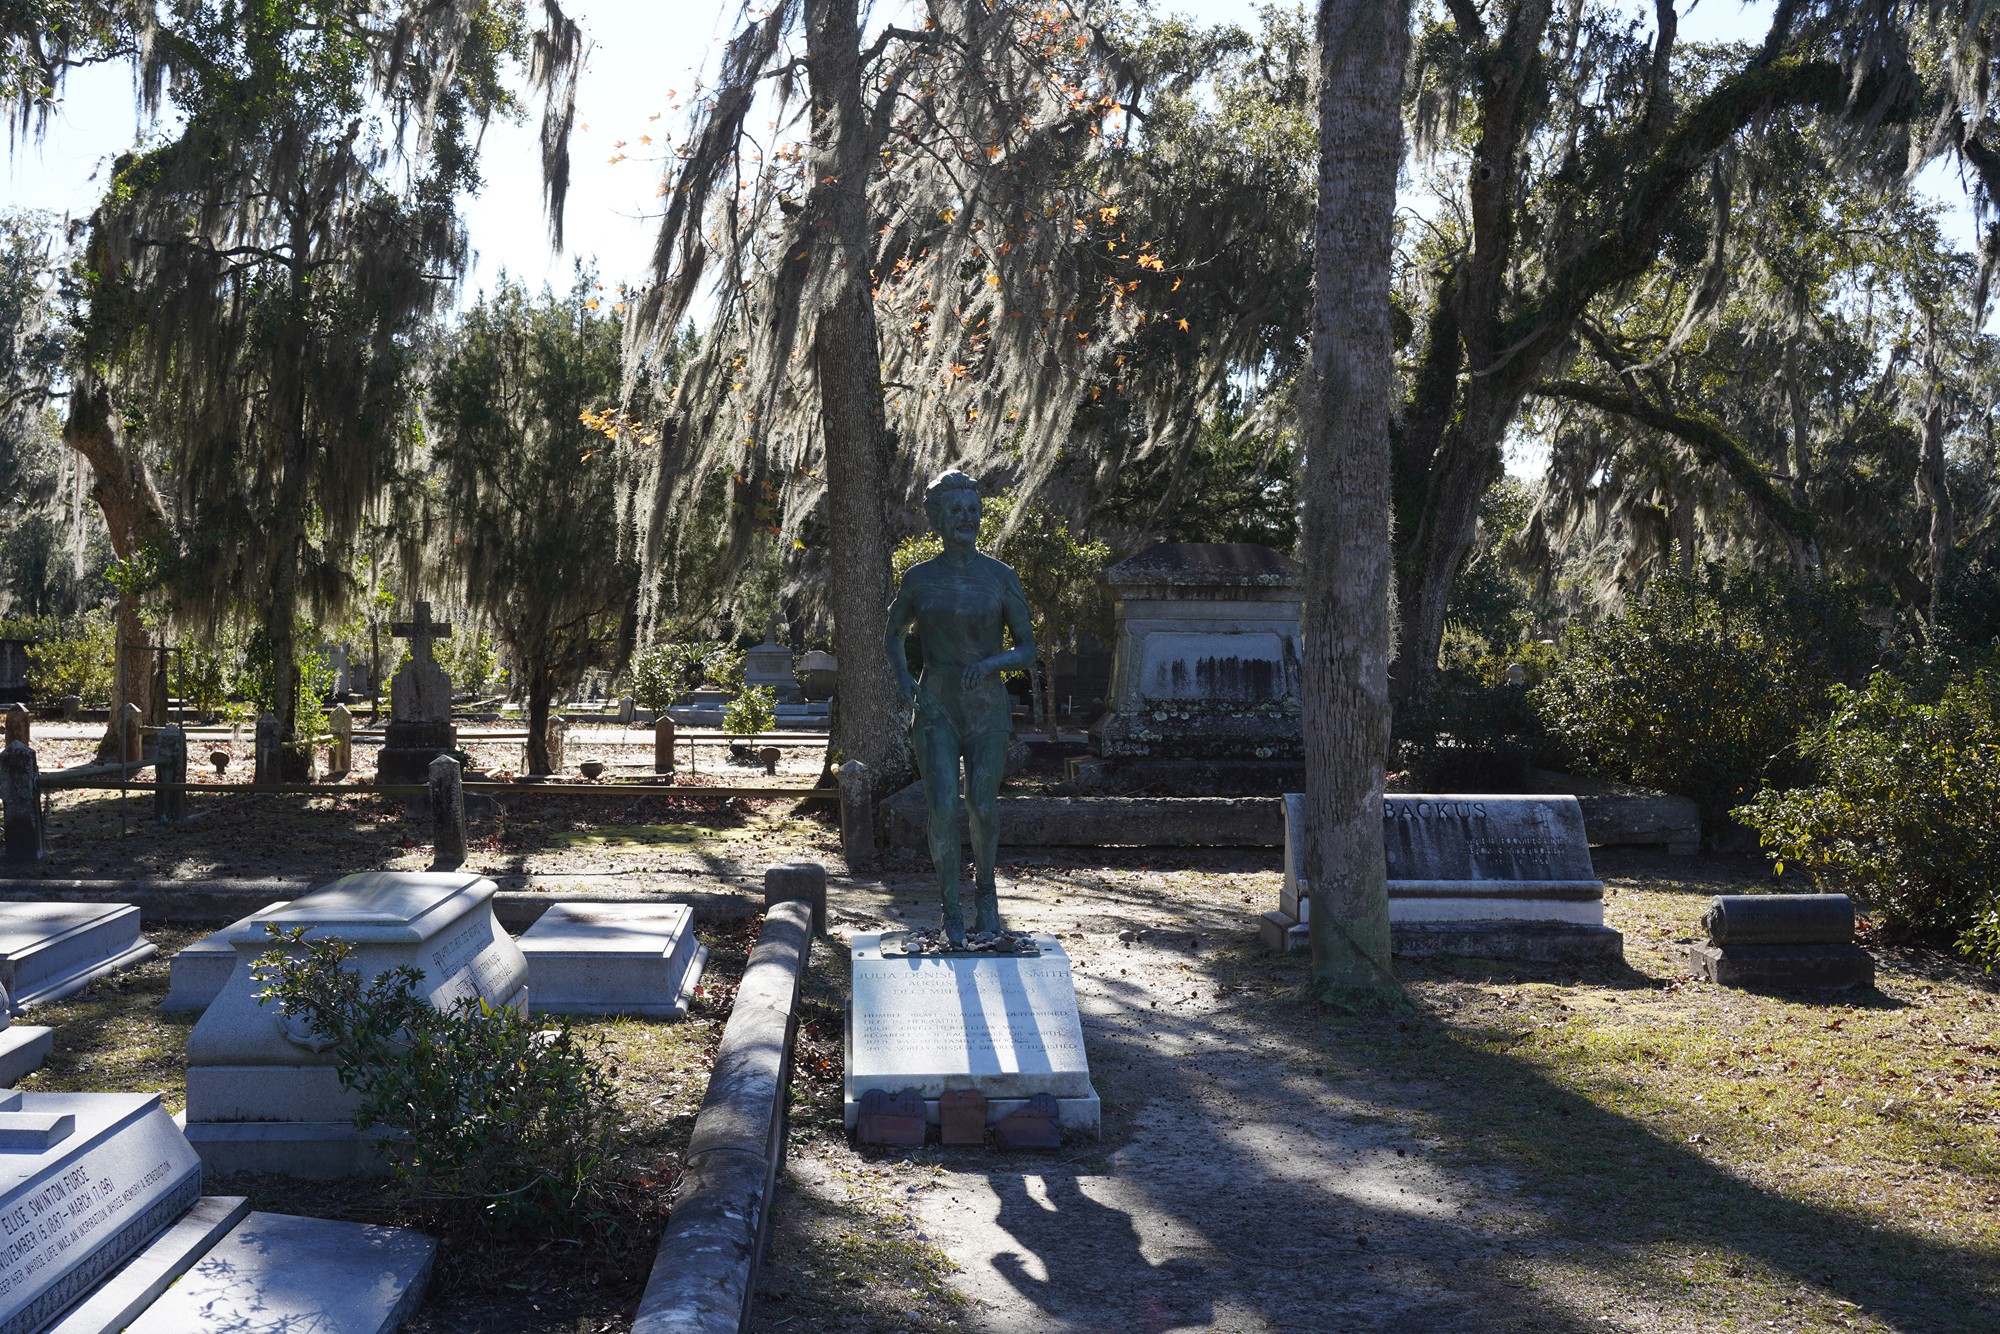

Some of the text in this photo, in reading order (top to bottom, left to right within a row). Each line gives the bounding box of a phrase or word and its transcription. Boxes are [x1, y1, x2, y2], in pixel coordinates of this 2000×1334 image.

[1383, 802, 1487, 819] BACKUS
[904, 971, 953, 979] DENISE
[1025, 970, 1069, 978] SMITH
[2, 1166, 90, 1235] ELISE SWINTON FURSE
[67, 1192, 95, 1219] MARCH
[0, 1278, 11, 1297] EEP
[43, 1244, 59, 1262] LIFE
[56, 1235, 70, 1250] WAS
[70, 1229, 80, 1242] AN
